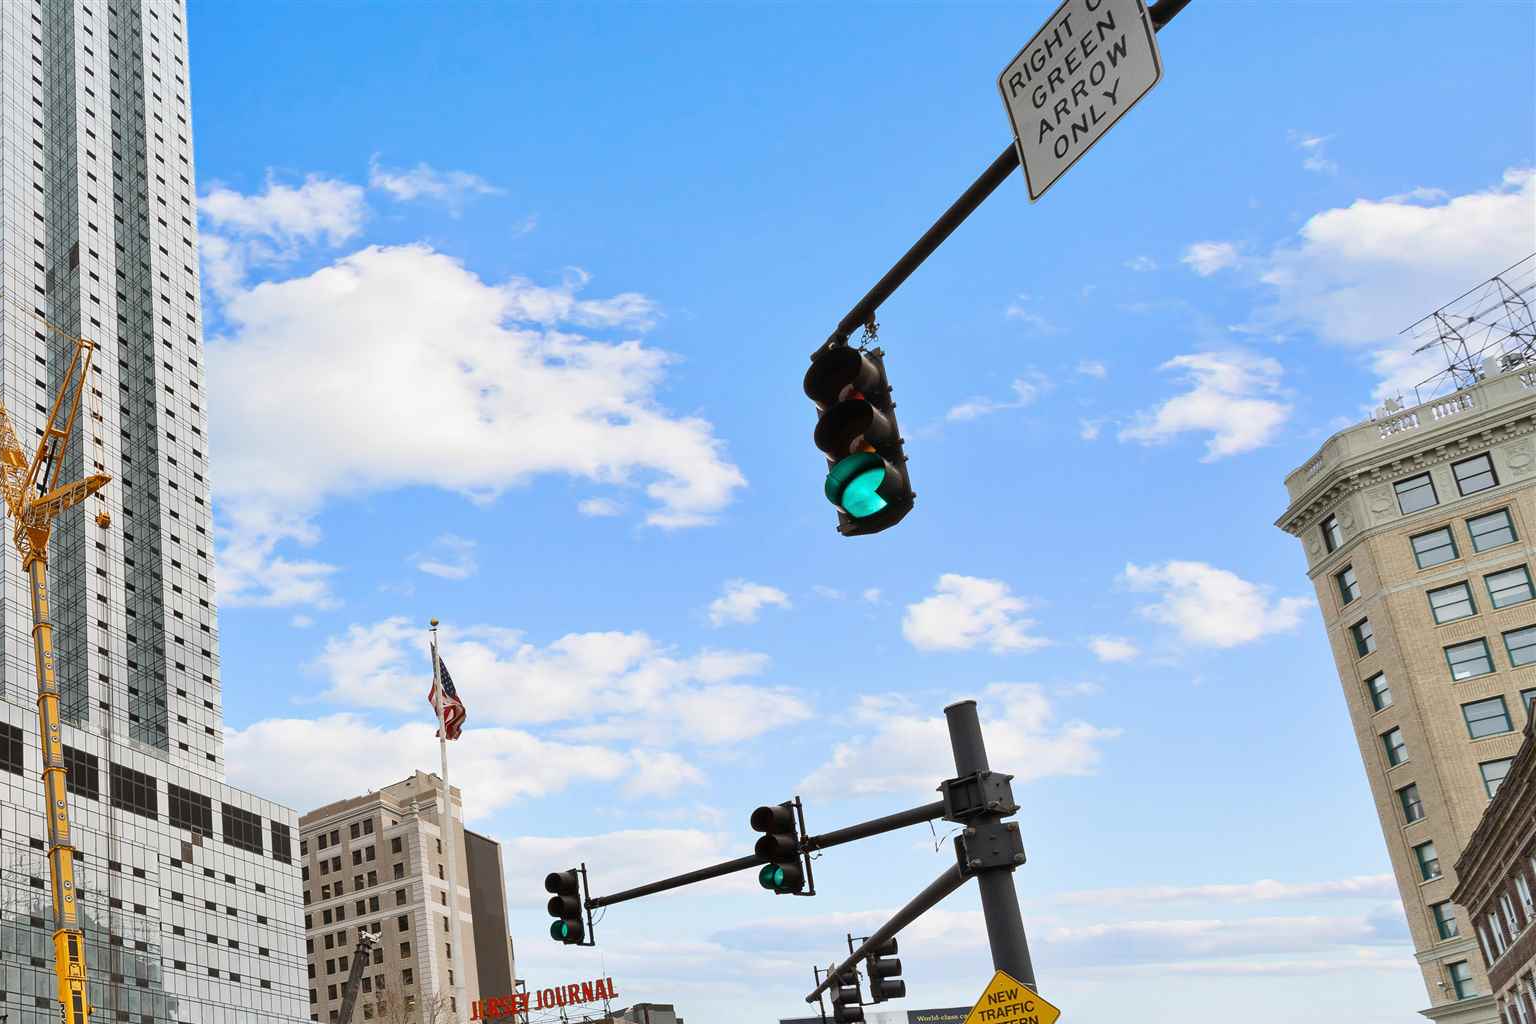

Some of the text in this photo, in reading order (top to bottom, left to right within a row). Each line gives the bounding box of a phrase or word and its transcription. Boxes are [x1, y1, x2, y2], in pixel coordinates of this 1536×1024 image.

[1008, 12, 1073, 98] RIGHT
[1031, 10, 1116, 109] GREEN
[1038, 34, 1127, 144] ARROW
[1054, 76, 1120, 159] ONLY
[470, 977, 619, 1021] JERSEY JOURNAL
[978, 1000, 1035, 1021] TRAFFIC
[987, 987, 1019, 1005] NEW
